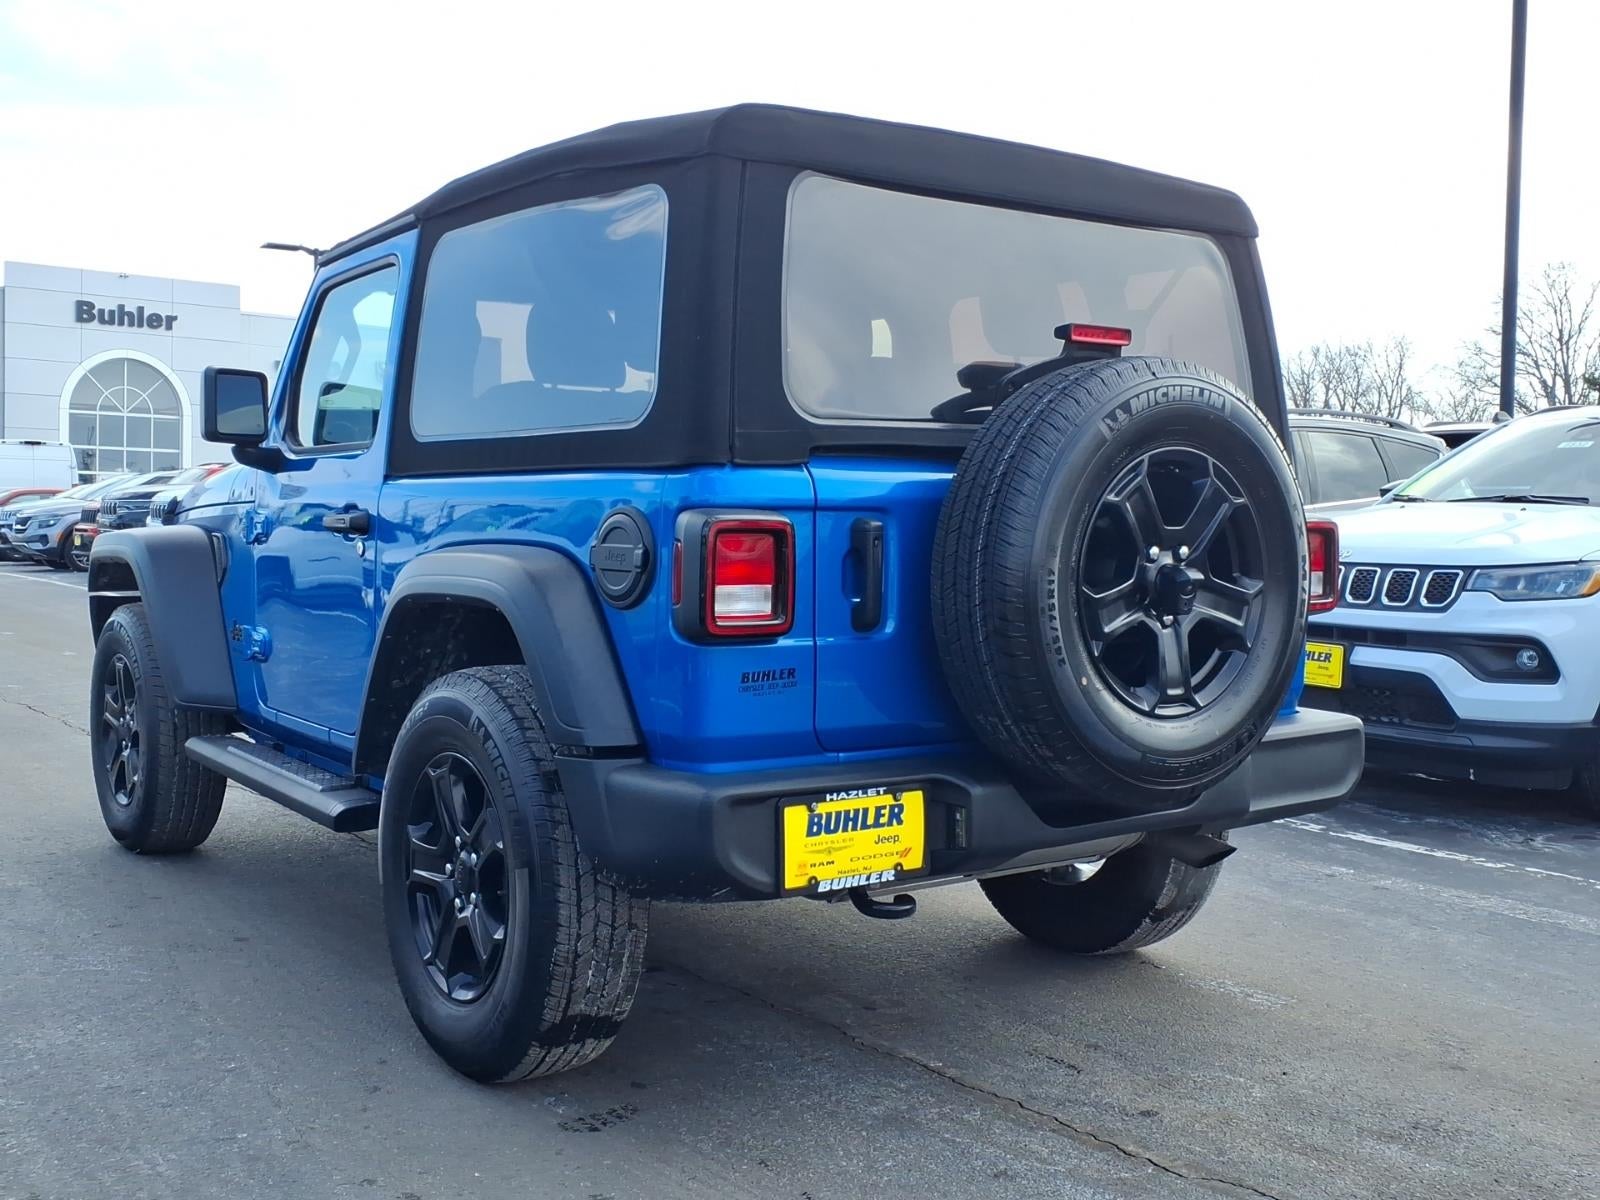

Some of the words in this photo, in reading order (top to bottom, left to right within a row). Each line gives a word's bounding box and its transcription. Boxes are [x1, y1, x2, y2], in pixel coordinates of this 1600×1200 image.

[75, 299, 178, 331] Buhler
[1129, 386, 1226, 415] MICHELIN
[740, 667, 797, 684] BUHLER
[826, 787, 887, 801] HAZLET
[806, 803, 904, 838] BUHLER
[874, 834, 900, 845] Jeep
[809, 860, 835, 869] RAM
[850, 851, 902, 862] DODGE
[818, 869, 896, 893] BUHLER
